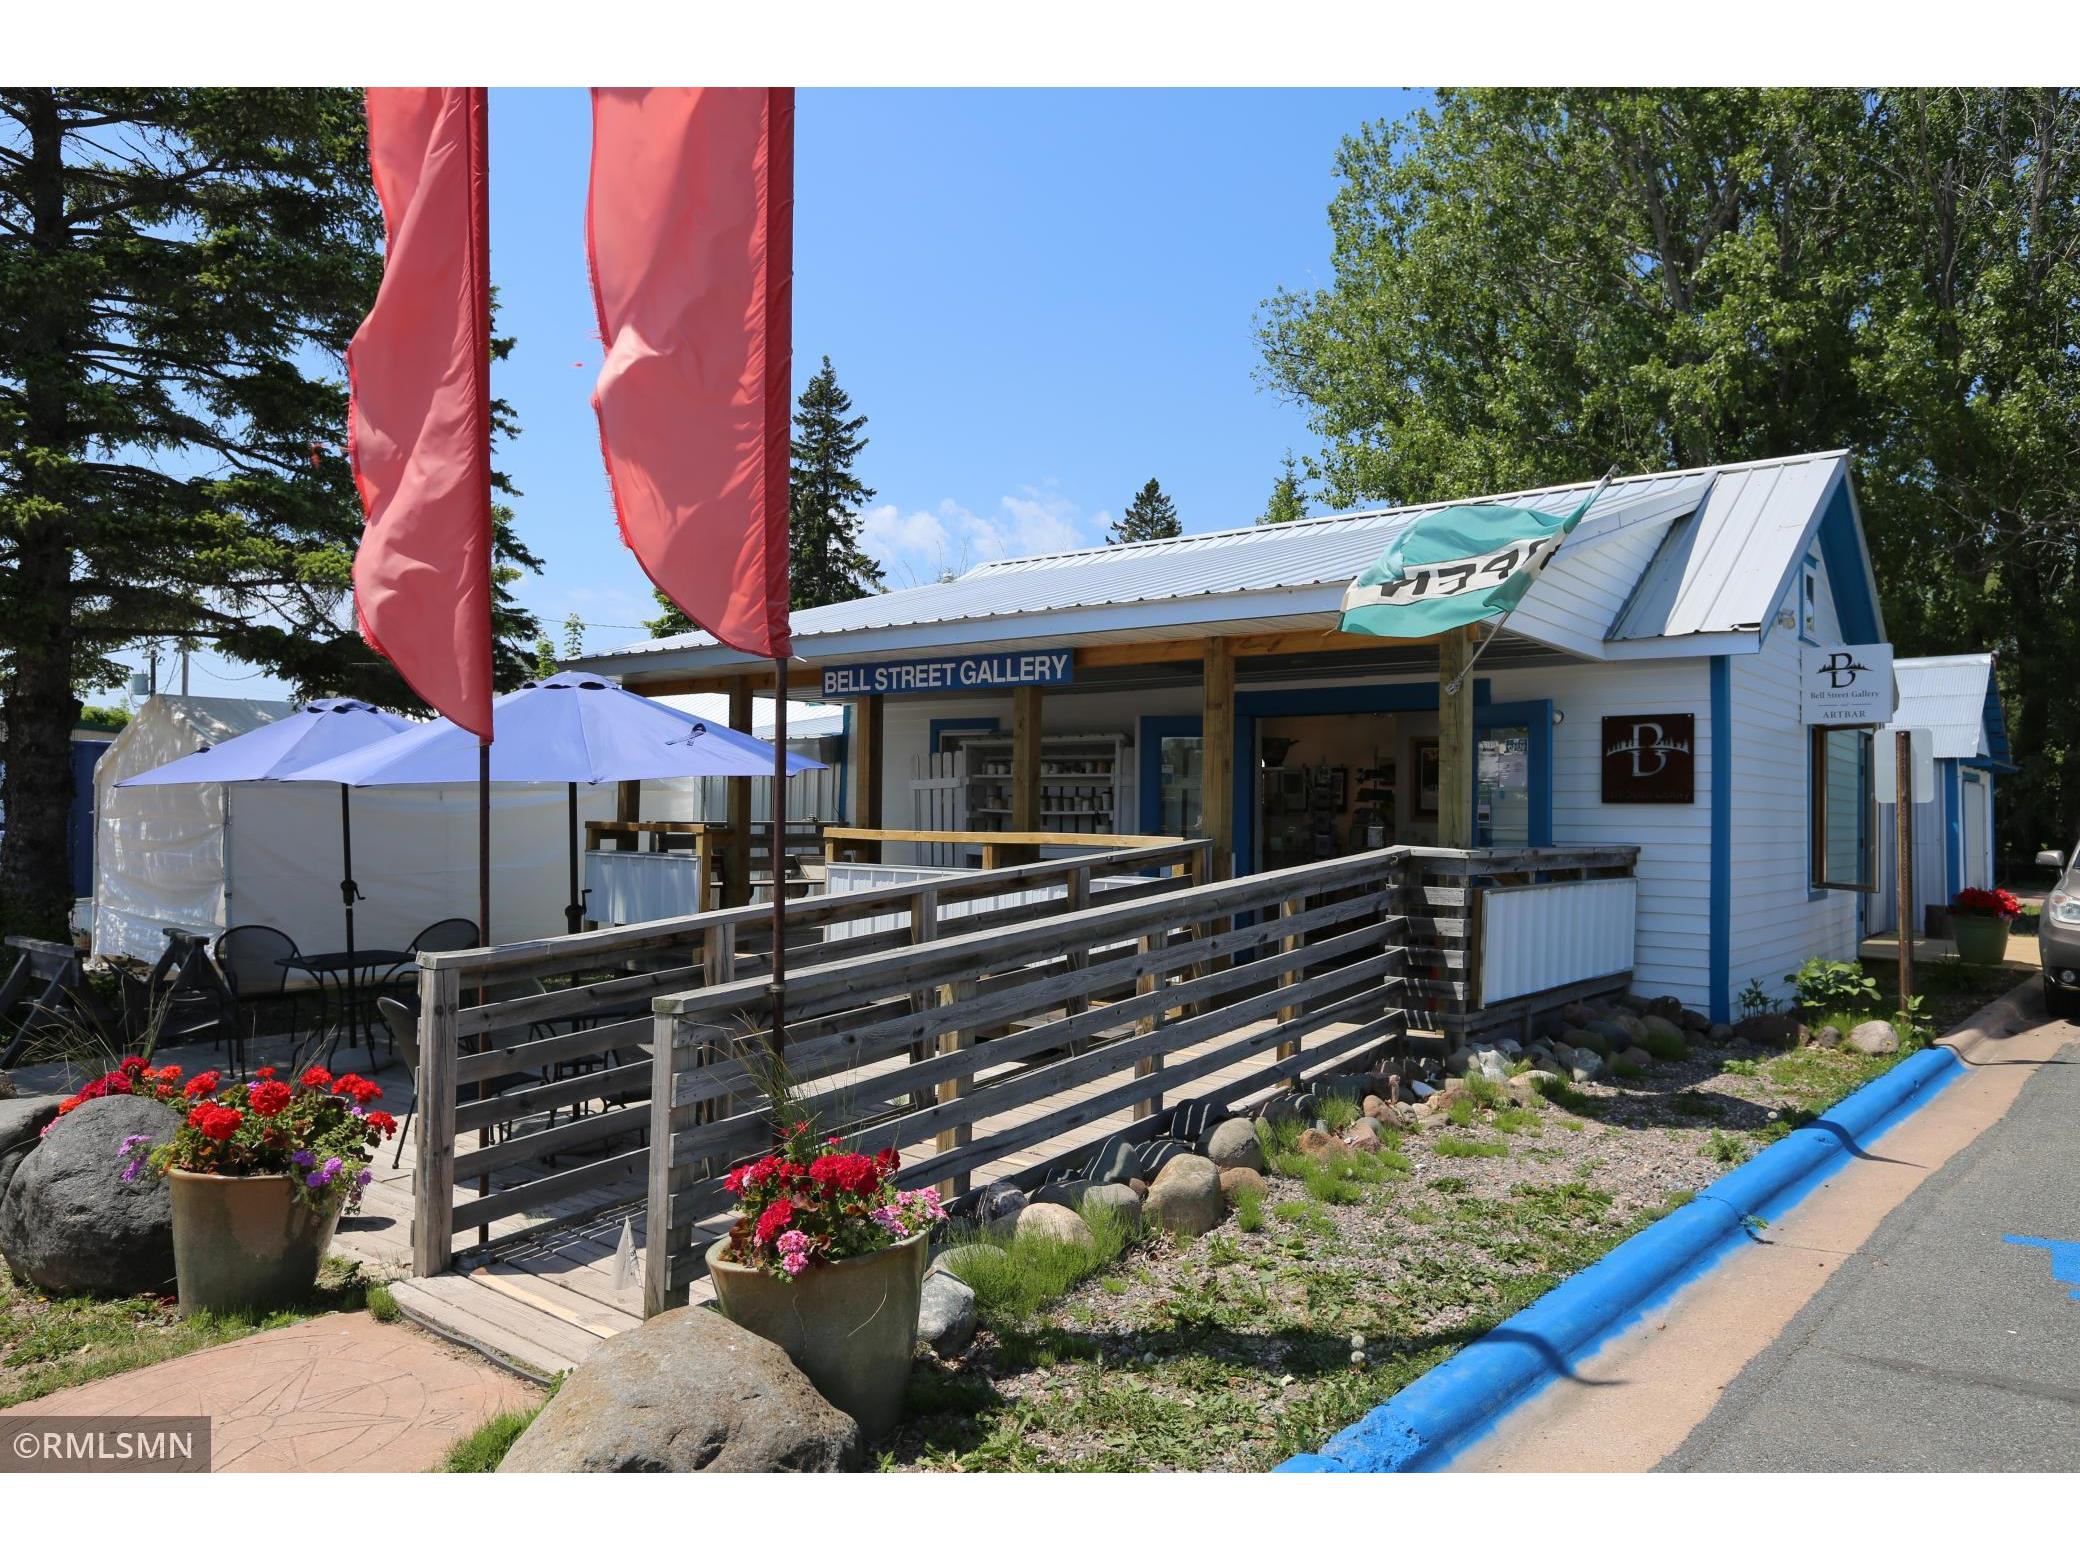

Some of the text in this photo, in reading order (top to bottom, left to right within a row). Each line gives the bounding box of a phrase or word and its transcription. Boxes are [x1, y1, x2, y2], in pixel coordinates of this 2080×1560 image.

[824, 654, 1068, 694] BELL STREET GALLERY
[1810, 690, 1880, 699] Bell Street Gallery
[1823, 710, 1866, 719] ARTBAR
